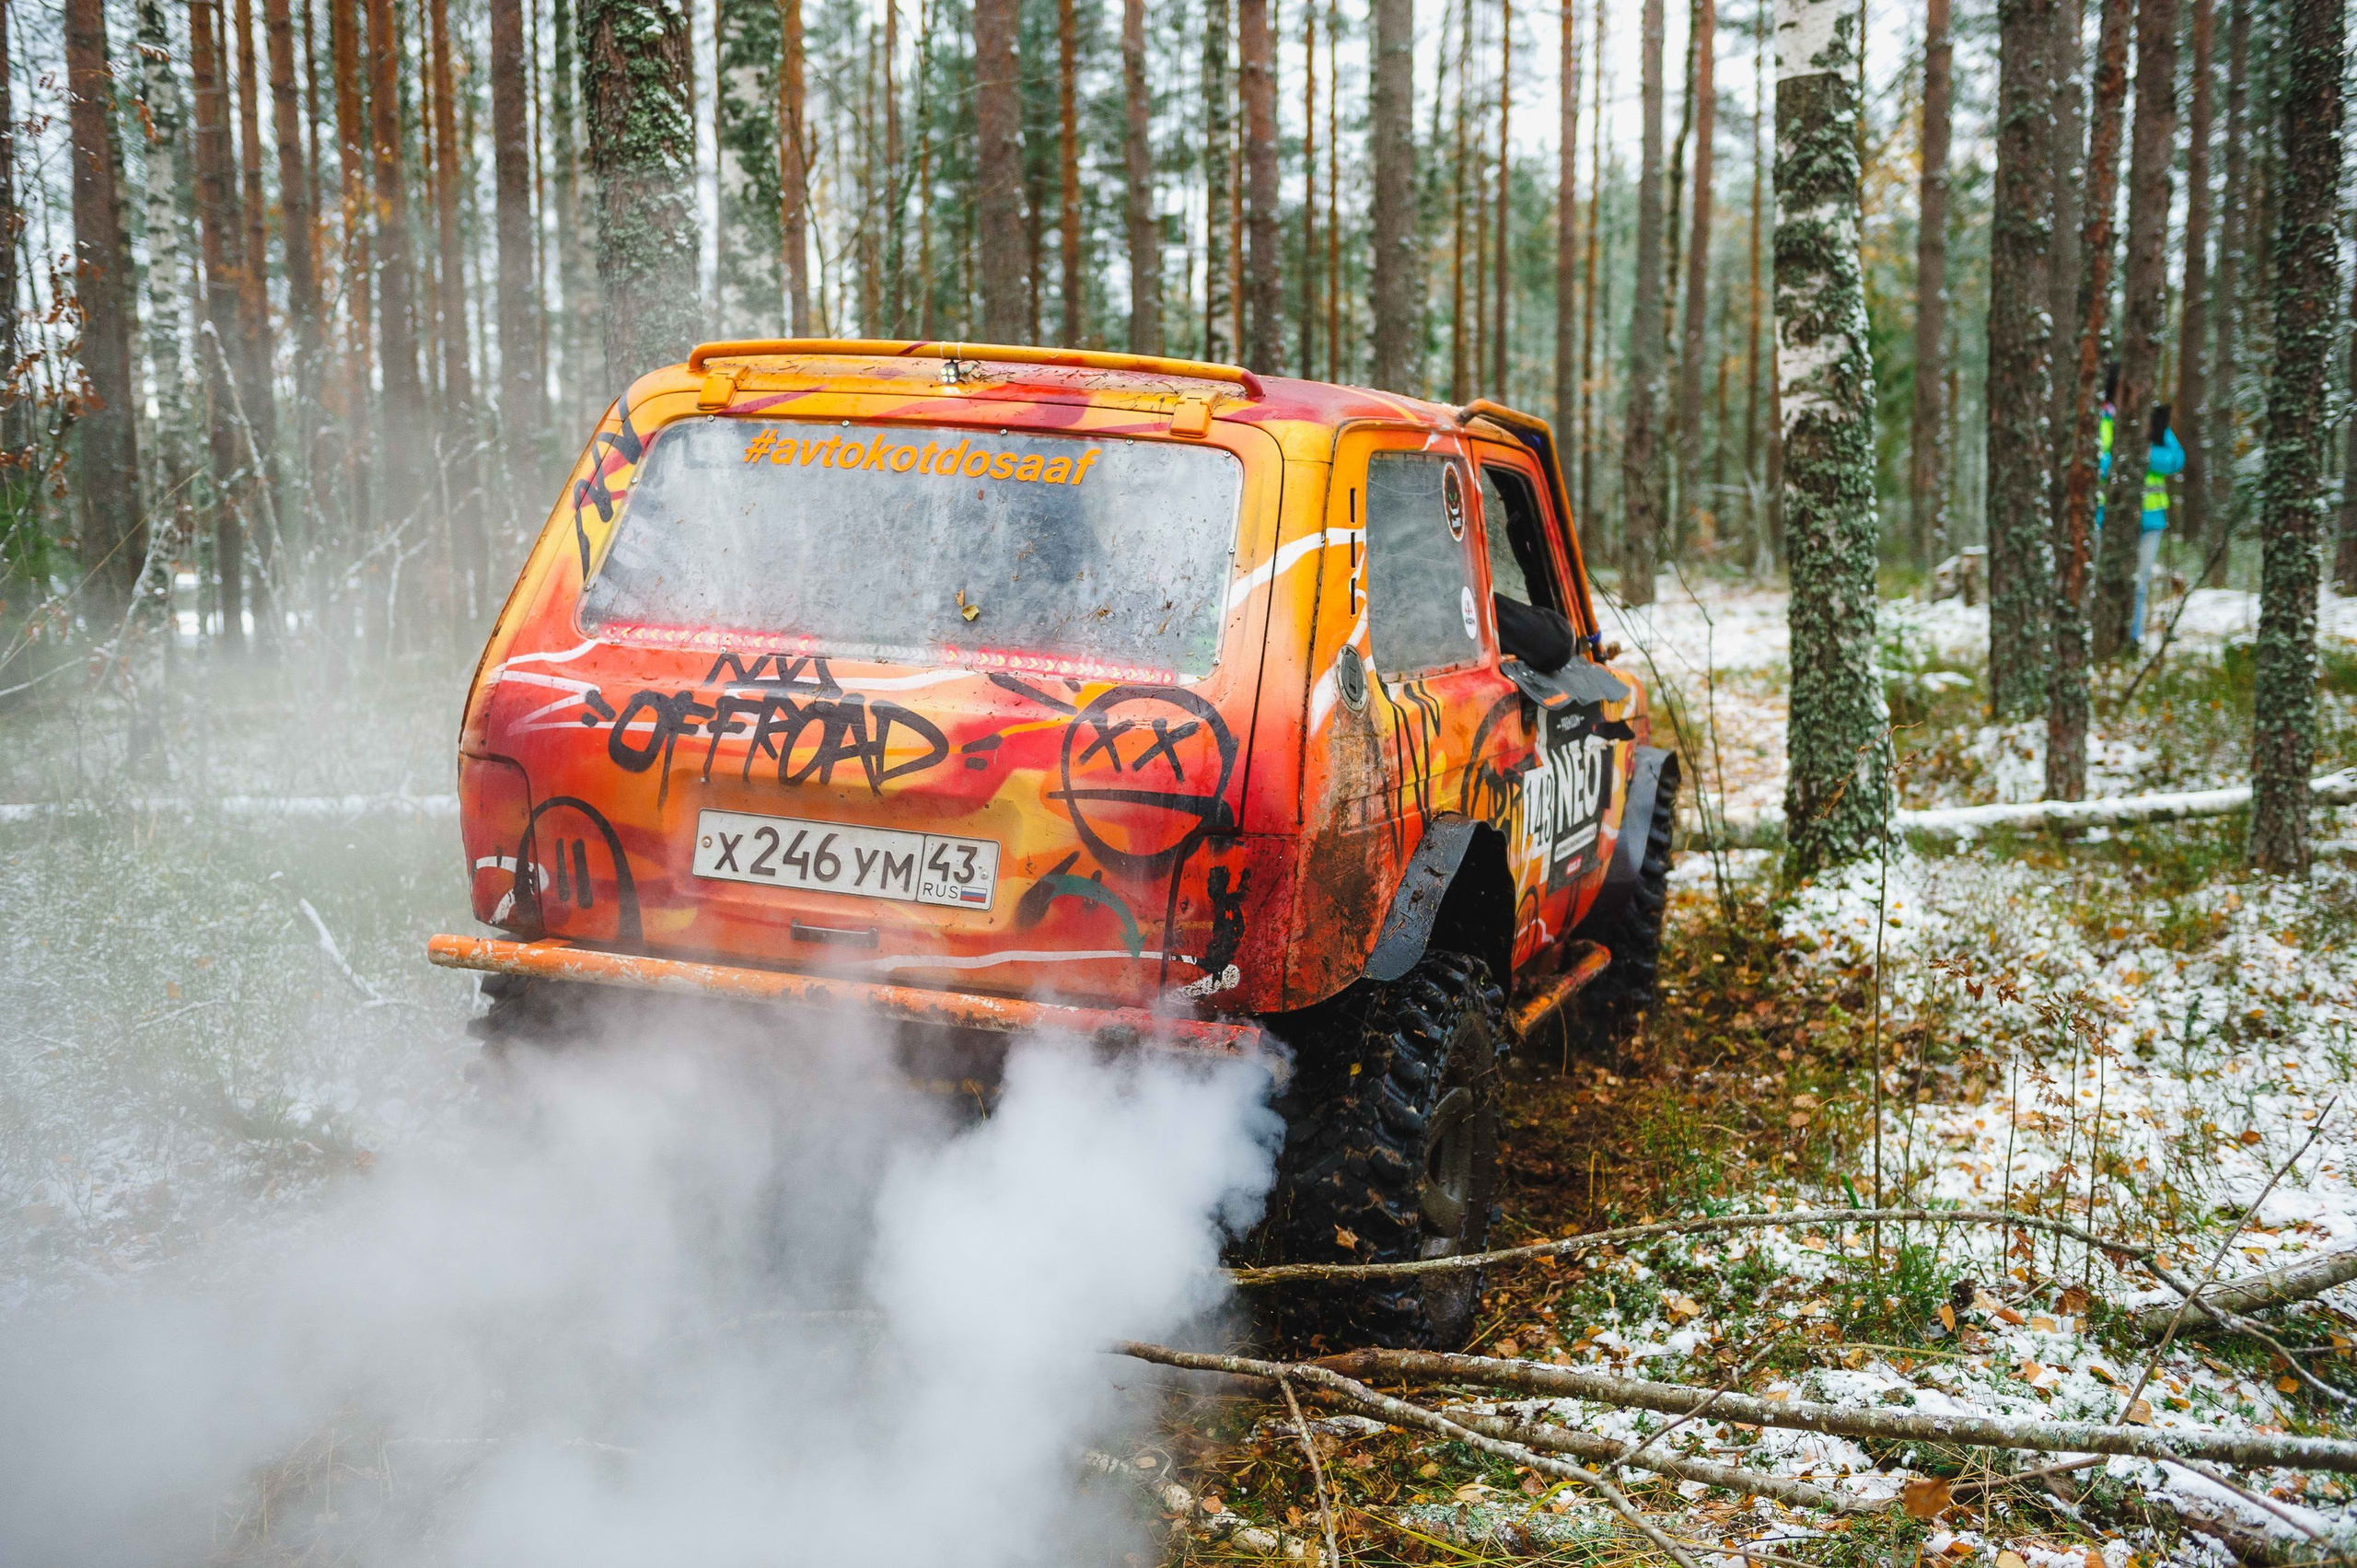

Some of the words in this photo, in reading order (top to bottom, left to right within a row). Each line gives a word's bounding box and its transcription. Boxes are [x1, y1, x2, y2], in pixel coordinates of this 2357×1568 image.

[744, 429, 1101, 485] #avtokotdosaaf
[609, 690, 949, 803] OFFROAD
[1551, 734, 1606, 833] NEO
[928, 842, 978, 883] 43
[923, 882, 958, 900] RUS
